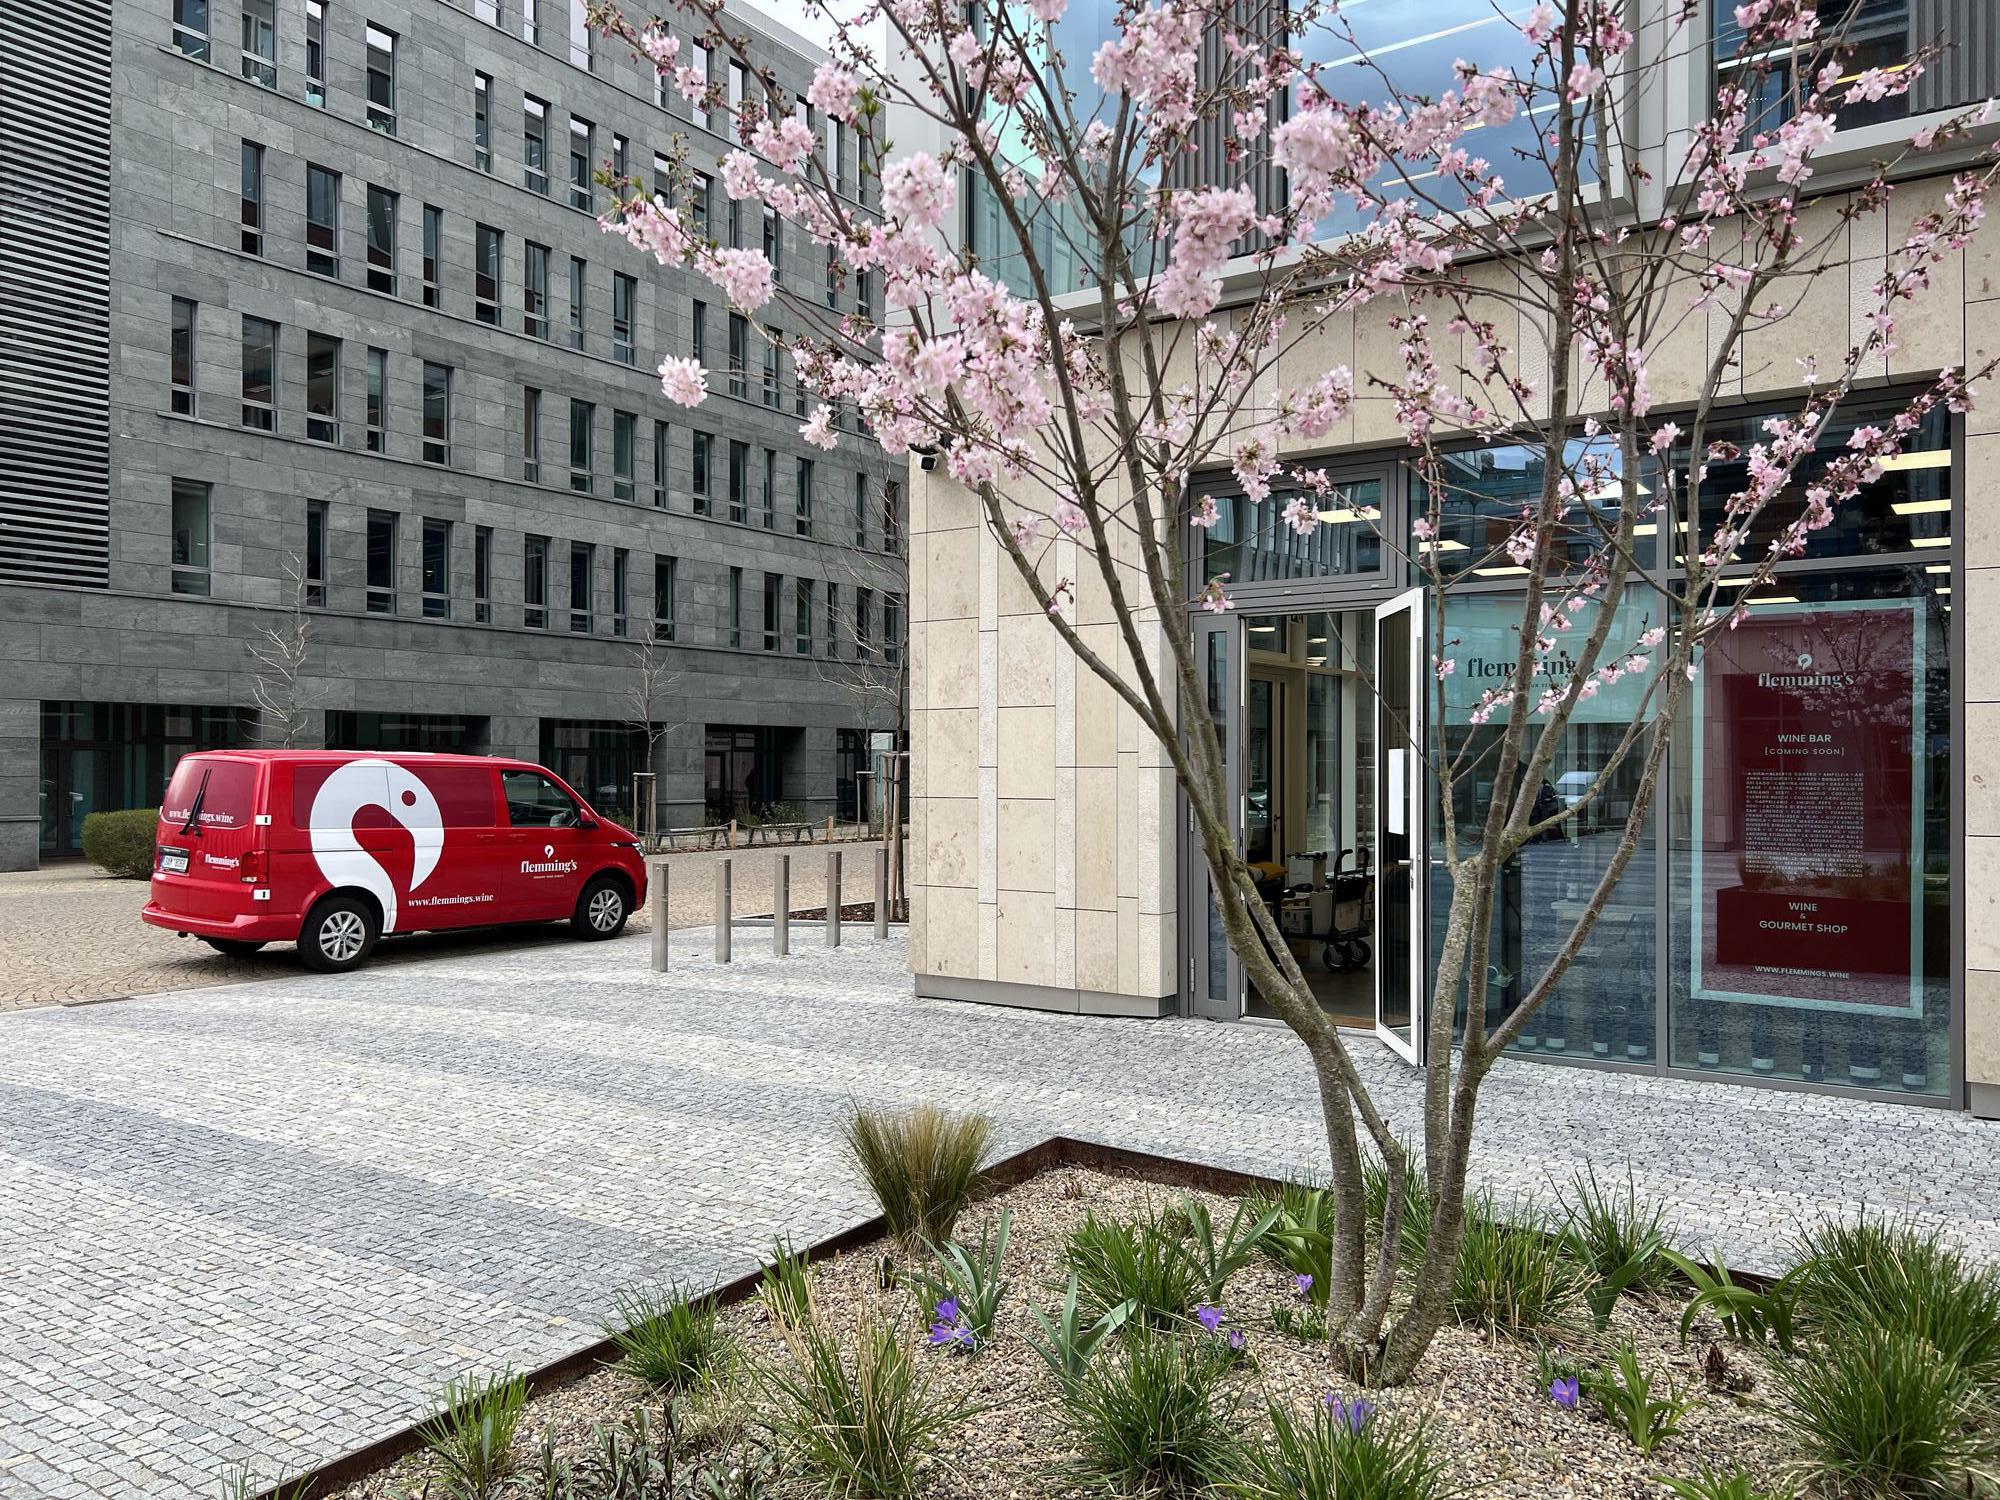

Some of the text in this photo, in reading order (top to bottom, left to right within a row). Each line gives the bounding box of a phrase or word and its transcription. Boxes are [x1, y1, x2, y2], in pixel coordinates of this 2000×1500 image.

[1758, 672, 1854, 688] flemming's
[1777, 734, 1832, 743] WINE BAR
[521, 859, 578, 873] flemming's
[408, 893, 493, 907] www.flemmings.wine
[1789, 902, 1818, 912] WINE
[1759, 920, 1848, 933] GOURMET SHOP
[1754, 965, 1849, 979] WWW.FLEMMINGS.WINE
